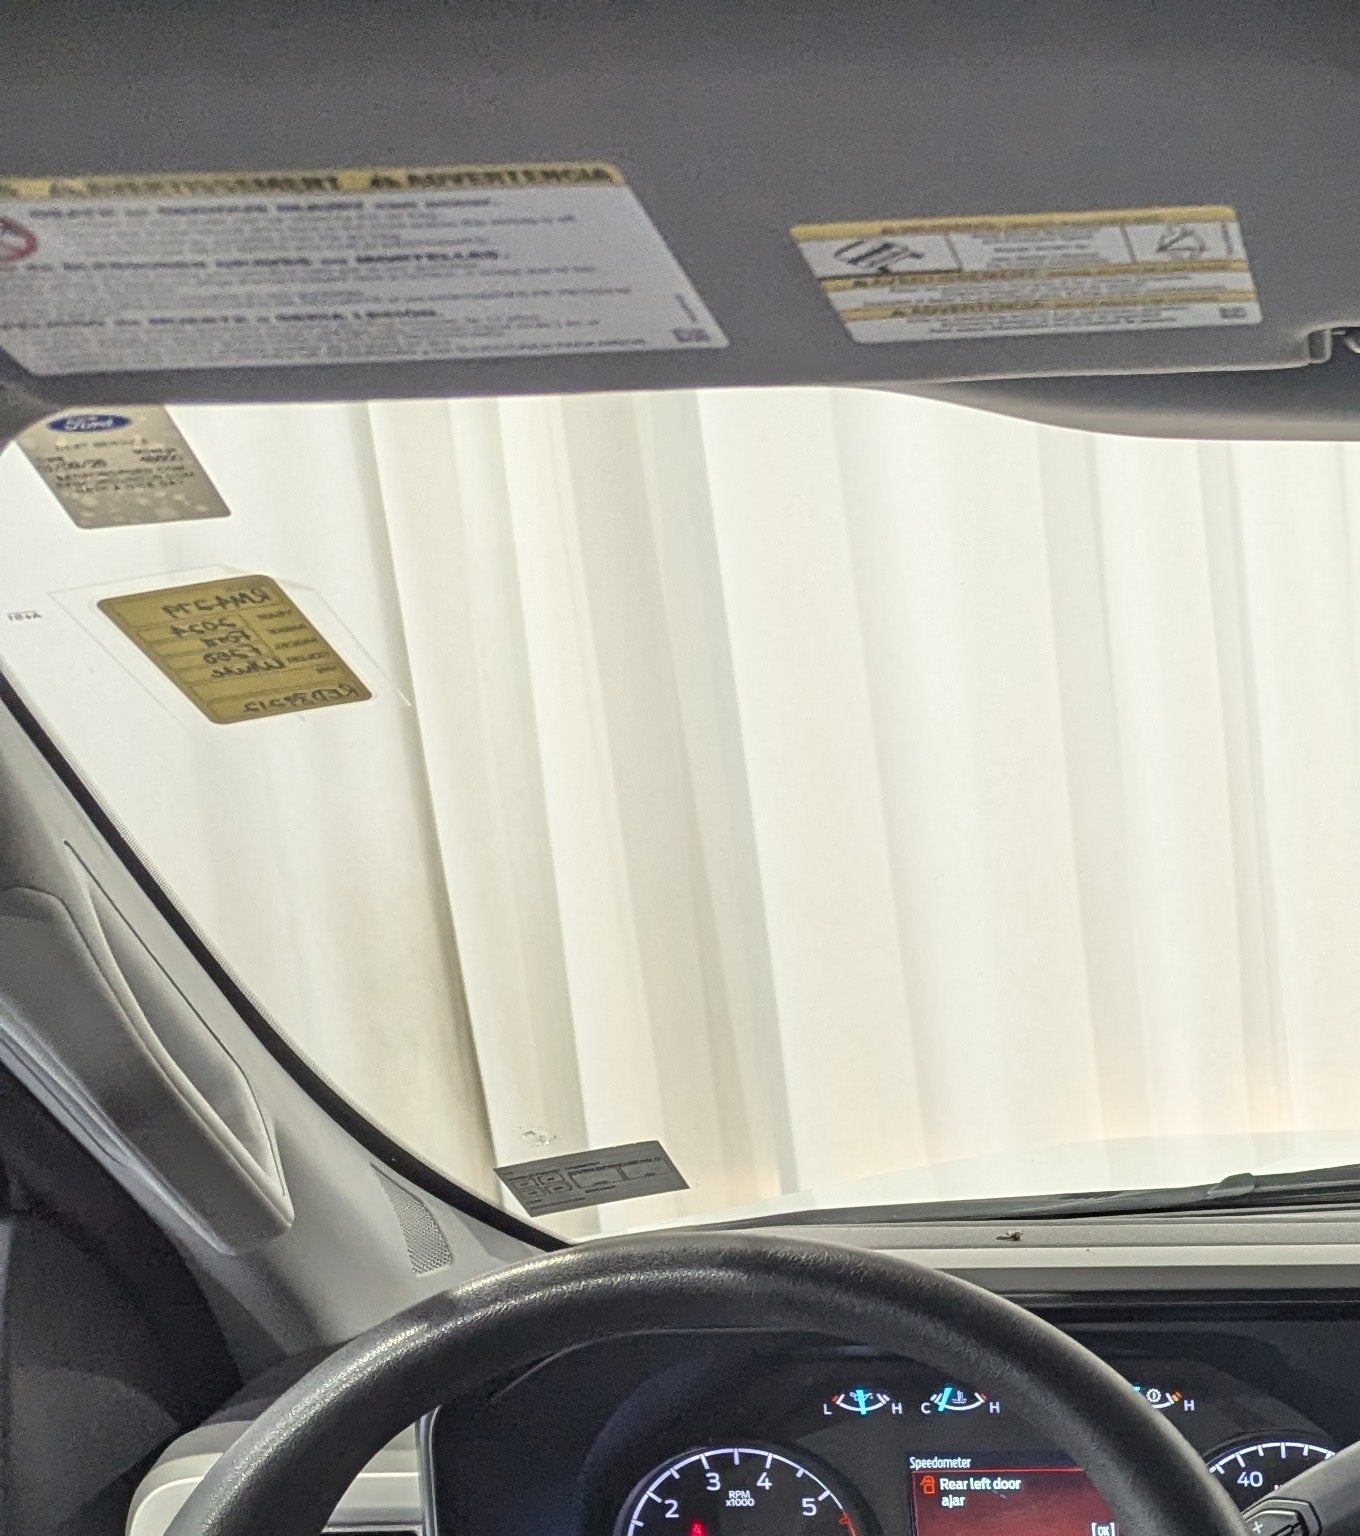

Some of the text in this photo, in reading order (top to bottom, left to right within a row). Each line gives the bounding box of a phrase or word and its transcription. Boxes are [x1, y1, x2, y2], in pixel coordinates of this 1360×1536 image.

[823, 1404, 833, 1415] L
[891, 1403, 903, 1415] H
[920, 1403, 931, 1414] C
[989, 1402, 1001, 1414] H
[1184, 1400, 1195, 1411] H
[909, 1456, 972, 1472] Speedometer
[706, 1472, 721, 1491] 3
[756, 1472, 773, 1490] 4
[940, 1477, 1022, 1491] Rear left door
[1237, 1470, 1264, 1488] 40
[728, 1490, 751, 1499] RPM
[941, 1494, 966, 1509] ajar
[664, 1499, 679, 1518] 2
[725, 1498, 755, 1507] x1000
[801, 1497, 817, 1516] 5
